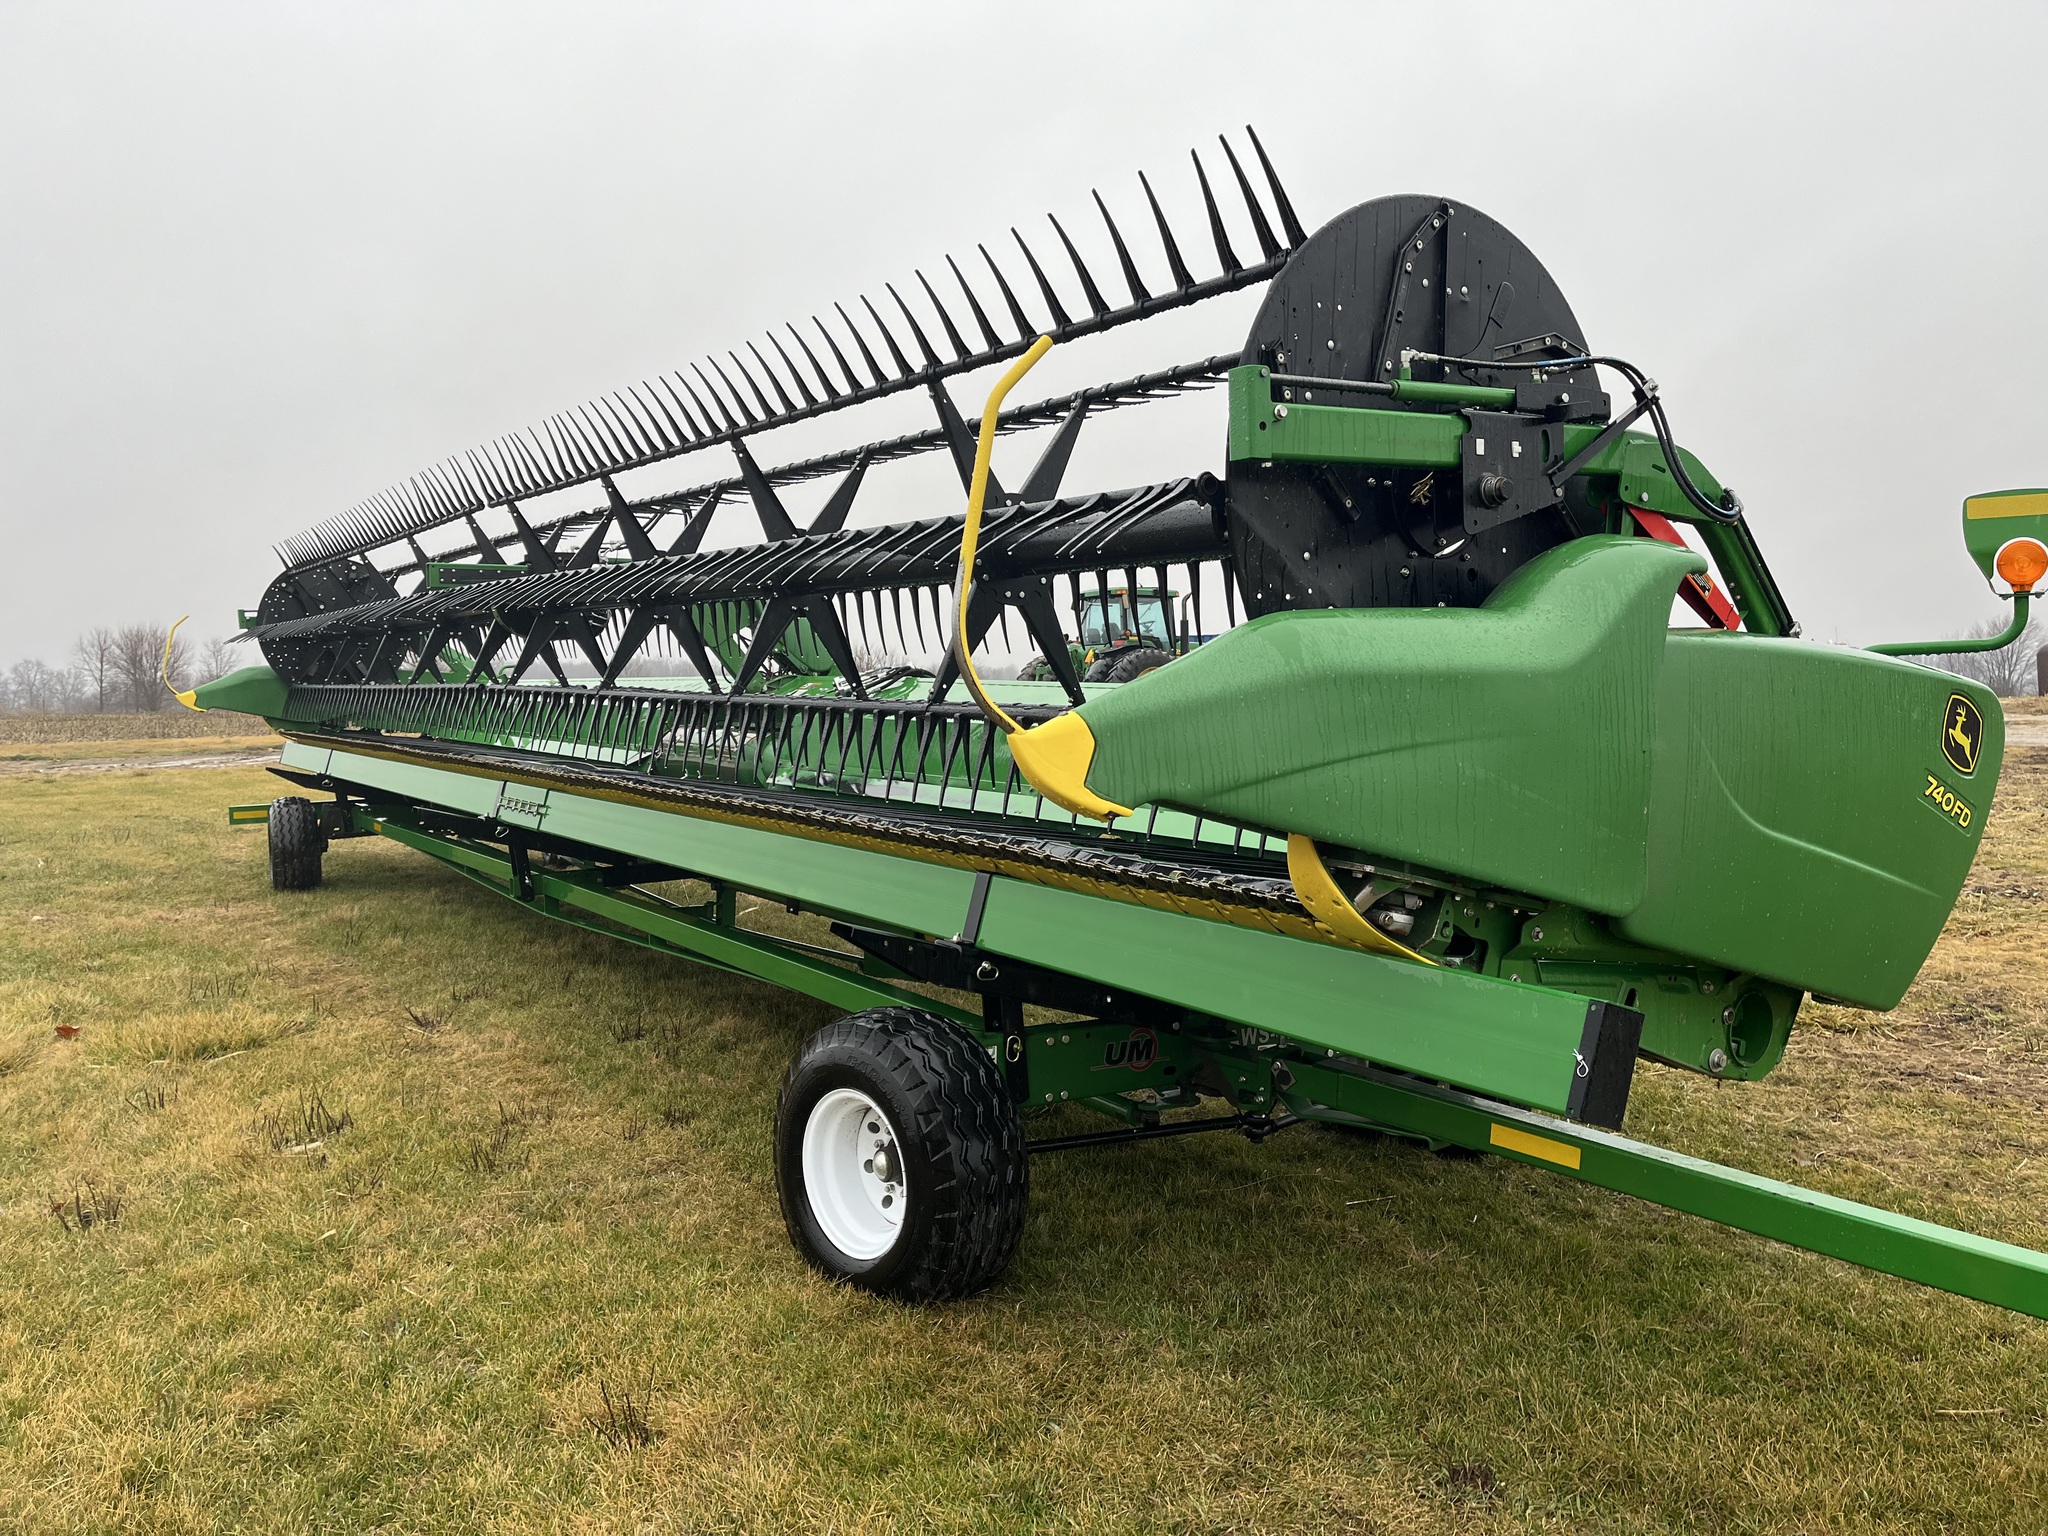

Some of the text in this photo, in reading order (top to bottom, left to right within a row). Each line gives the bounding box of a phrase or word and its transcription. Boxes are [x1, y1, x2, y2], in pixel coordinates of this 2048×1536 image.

[1924, 775, 1972, 828] 740FD
[1104, 1038, 1155, 1066] UM
[846, 1055, 920, 1145] CARLISLE
